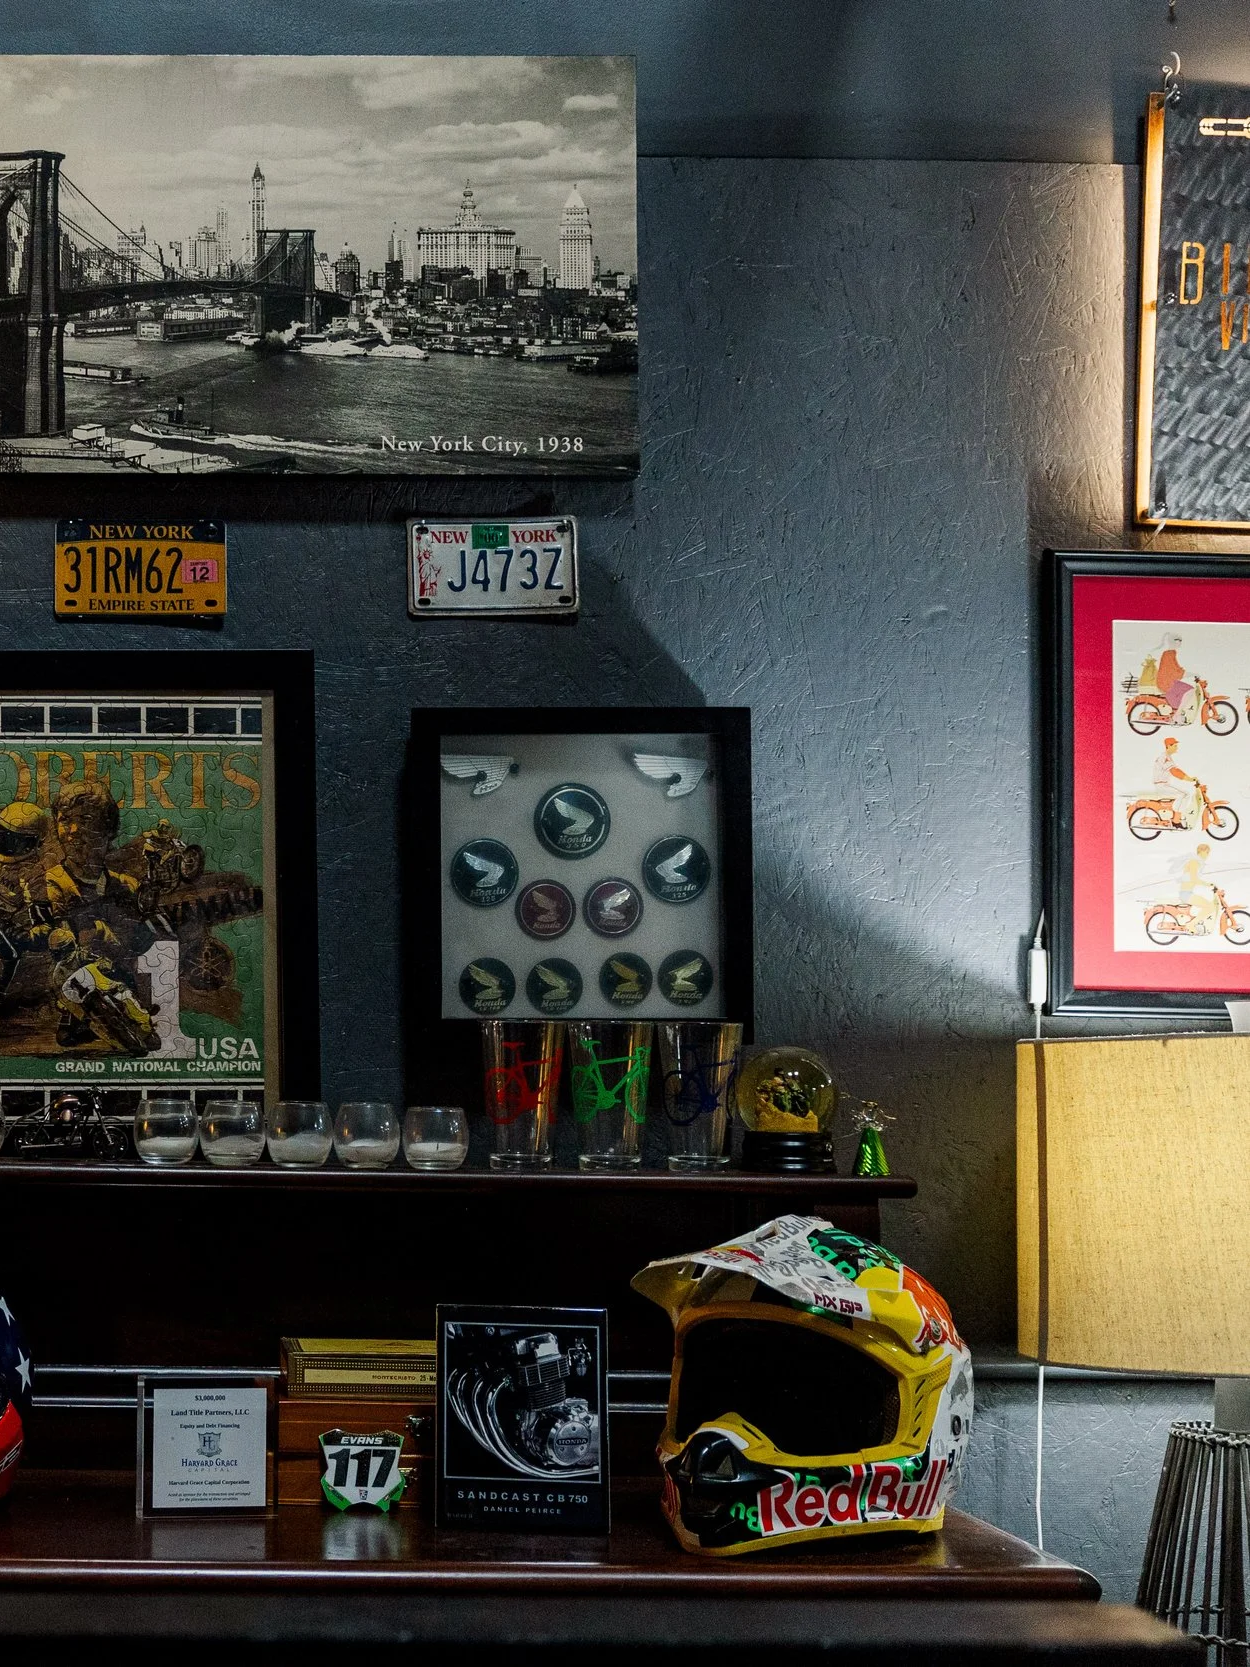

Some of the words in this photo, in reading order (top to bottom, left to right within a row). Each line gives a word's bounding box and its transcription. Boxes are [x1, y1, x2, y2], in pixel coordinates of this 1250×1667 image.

[380, 435, 423, 451] New
[430, 435, 474, 451] York
[481, 436, 528, 457] City,
[538, 437, 584, 452] 1938
[89, 525, 137, 539] NEW
[142, 525, 194, 539] YORK
[430, 531, 469, 544] NEW
[511, 529, 557, 543] YORK
[63, 546, 184, 594] 31RM62
[190, 566, 210, 580] 12
[447, 547, 564, 592] J473Z
[88, 598, 146, 611] EMPIRE
[150, 598, 195, 611] STATE
[661, 883, 697, 893] Honda
[136, 940, 197, 1059] 1
[201, 1037, 260, 1059] USA
[55, 1061, 106, 1073] GRAND
[112, 1061, 181, 1072] NATIONAL
[186, 1060, 261, 1072] CHAMPION
[340, 1436, 384, 1445] EVANS
[328, 1448, 397, 1488] 117
[457, 1490, 540, 1502] SANDCAST
[546, 1494, 565, 1502] CB
[568, 1494, 588, 1504] 750
[758, 1463, 865, 1534] Red
[867, 1459, 947, 1519] Bull
[483, 1505, 520, 1513] DANIEL
